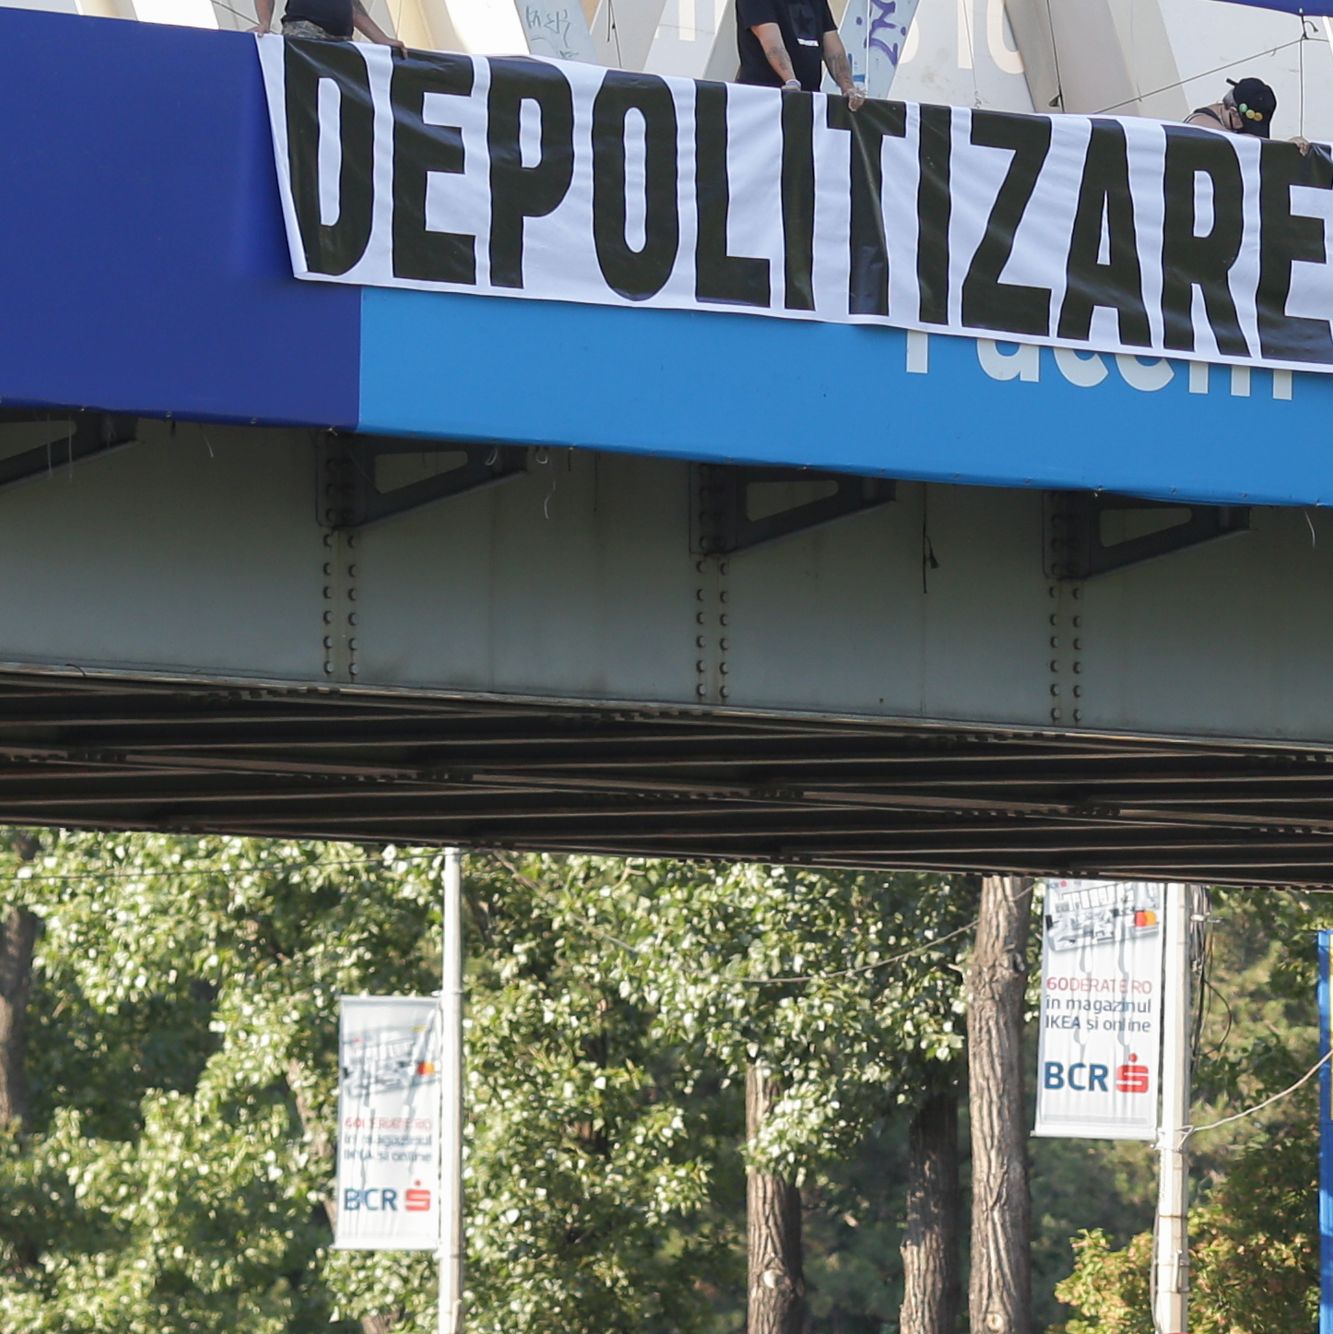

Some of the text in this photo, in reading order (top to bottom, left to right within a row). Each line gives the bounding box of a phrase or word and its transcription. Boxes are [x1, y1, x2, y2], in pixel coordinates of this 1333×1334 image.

[1066, 998, 1151, 1014] magazinul
[1045, 1015, 1081, 1029] IKEA
[1103, 1016, 1151, 1032] online
[1044, 1061, 1109, 1092] BCR
[344, 1187, 398, 1212] BCR
